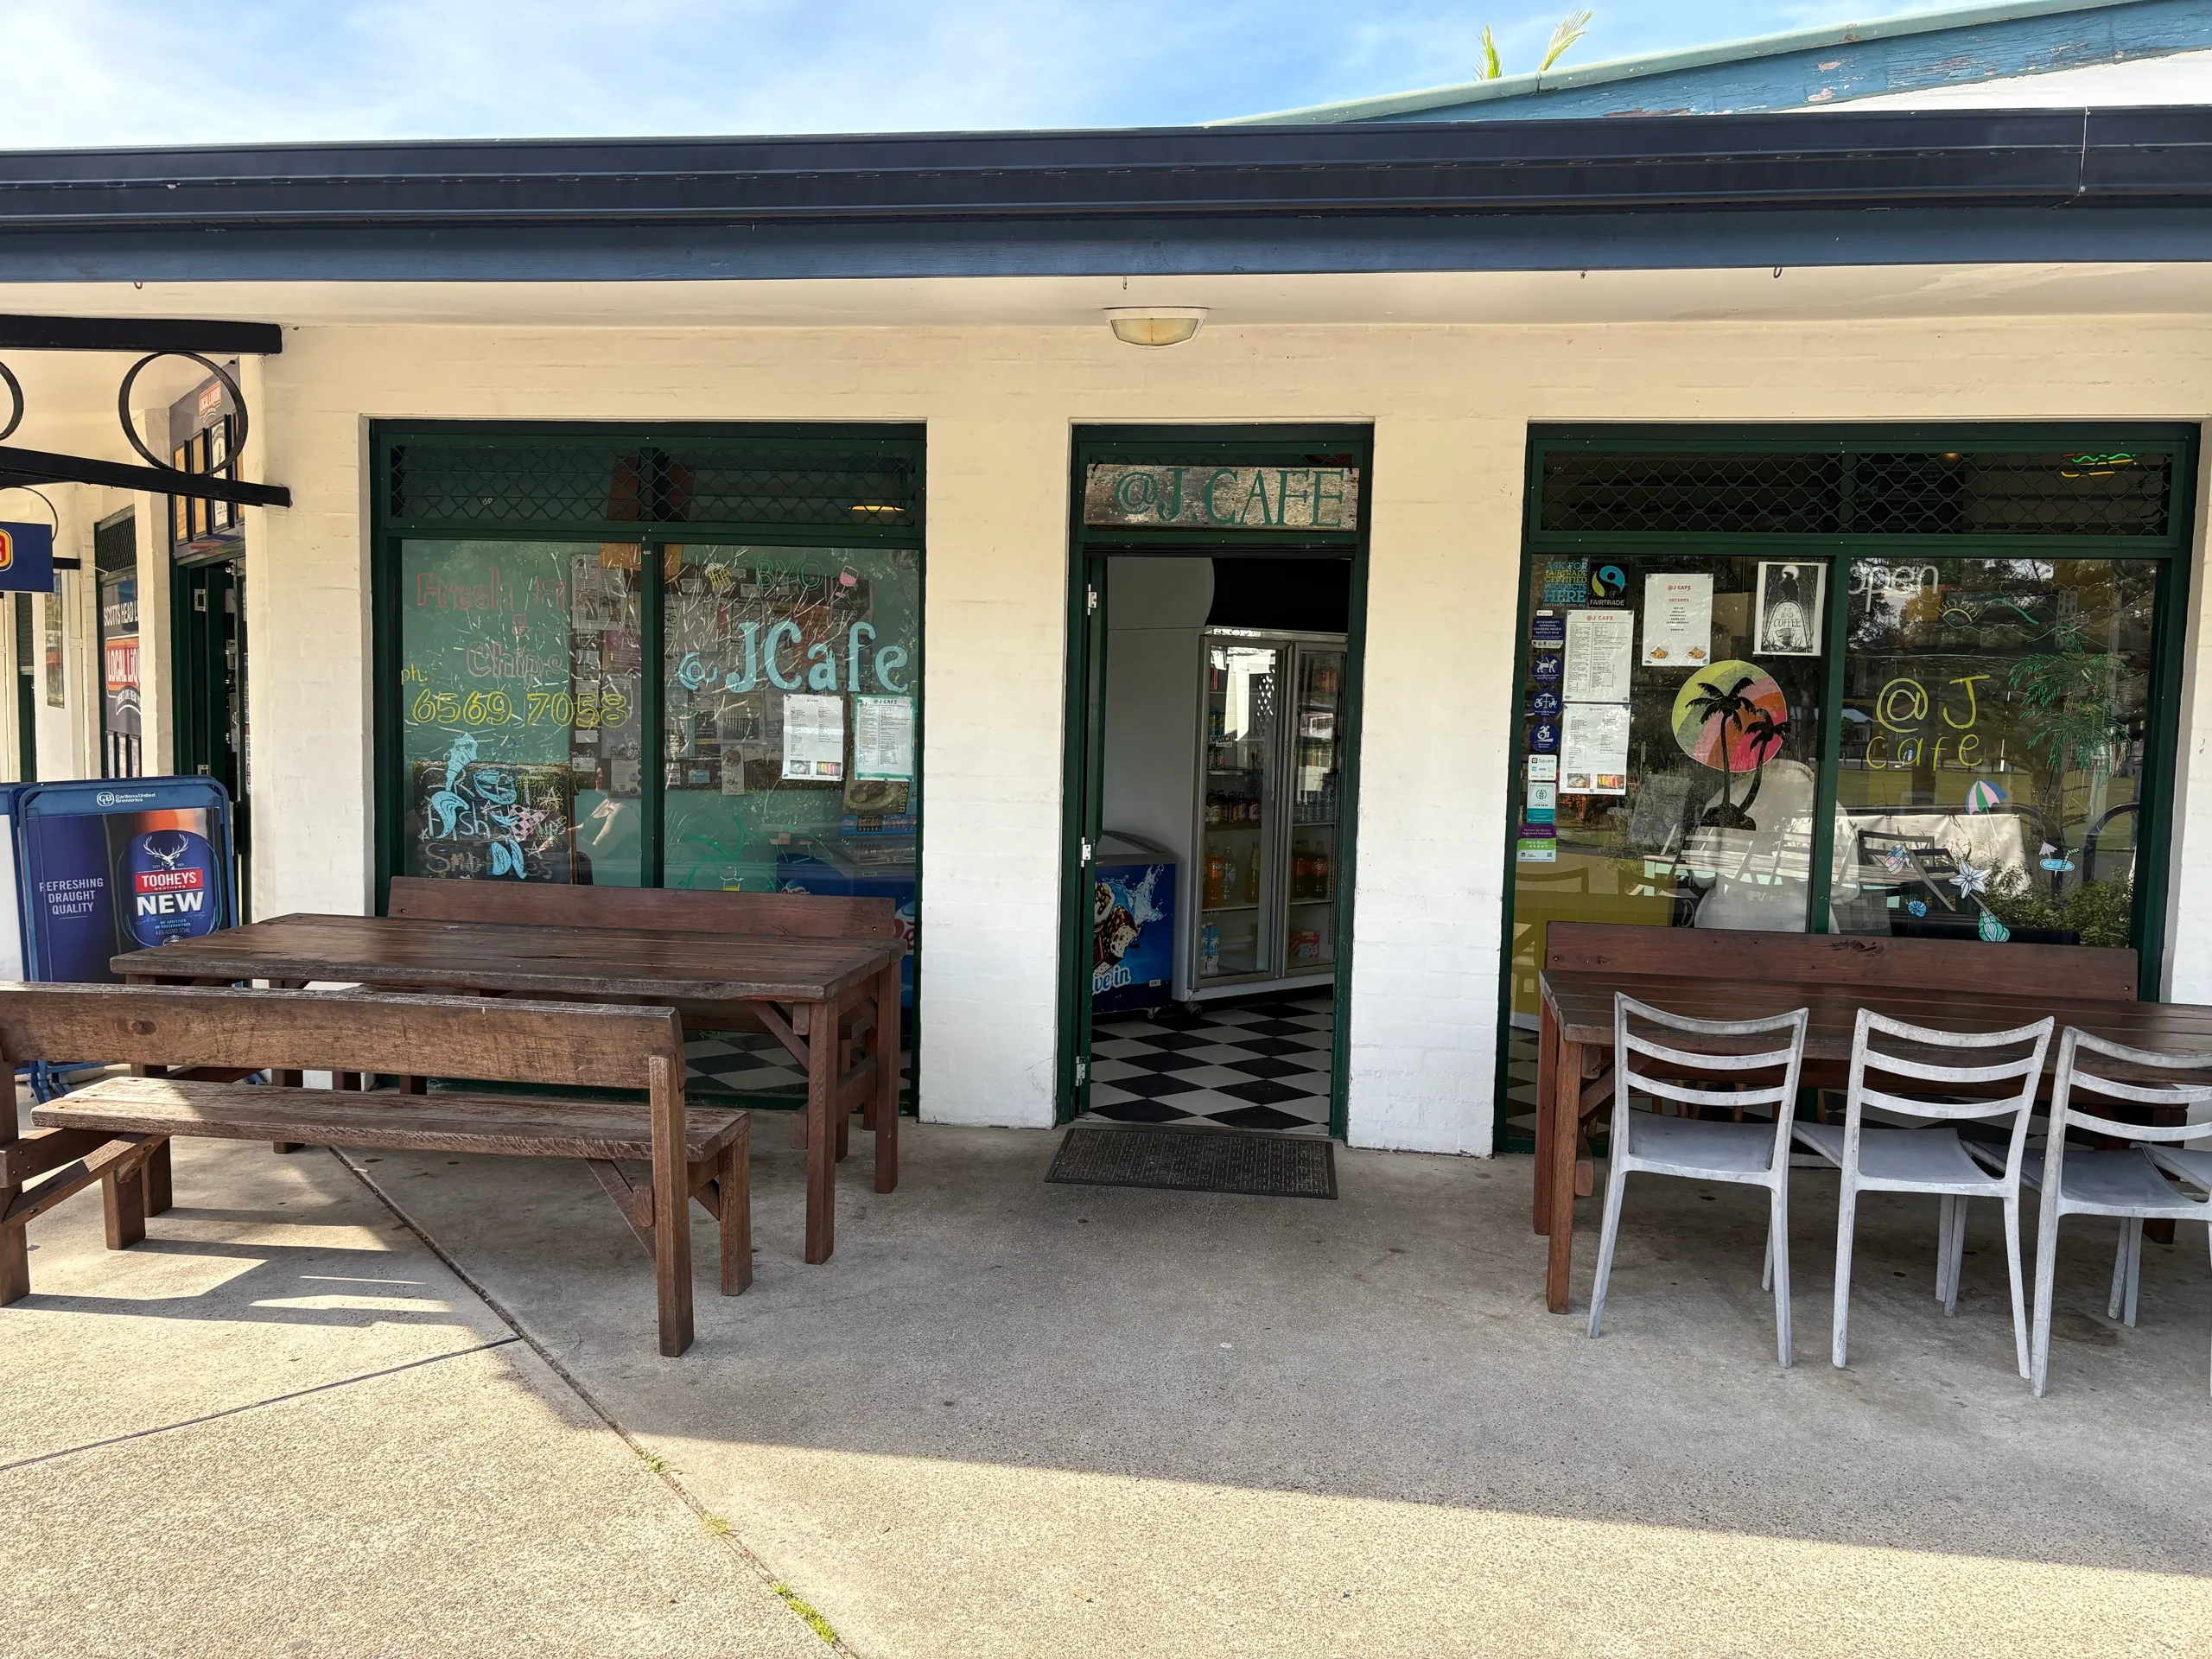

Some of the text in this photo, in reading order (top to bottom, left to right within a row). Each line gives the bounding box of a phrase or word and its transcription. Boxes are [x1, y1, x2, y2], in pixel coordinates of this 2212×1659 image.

[1204, 467, 1344, 528] CAFE
[756, 558, 823, 593] BYO
[1546, 562, 1587, 570] ASK FOR
[416, 565, 514, 611] Fresh
[1543, 590, 1586, 603] HERE
[104, 604, 121, 626] SCOTTS
[121, 600, 134, 624] HEAD
[1773, 618, 1802, 628] COFFEE
[107, 648, 128, 683] LOCAL
[467, 641, 564, 690] Chips
[412, 688, 630, 728] 6569 7058
[1866, 734, 1983, 772] cafe
[39, 877, 104, 893] REFRESHING
[142, 871, 197, 887] TOOHEYS
[48, 890, 96, 904] DRAUGHT
[52, 902, 94, 915] QUALITY
[137, 891, 205, 917] NEW
[1113, 965, 1131, 988] in
